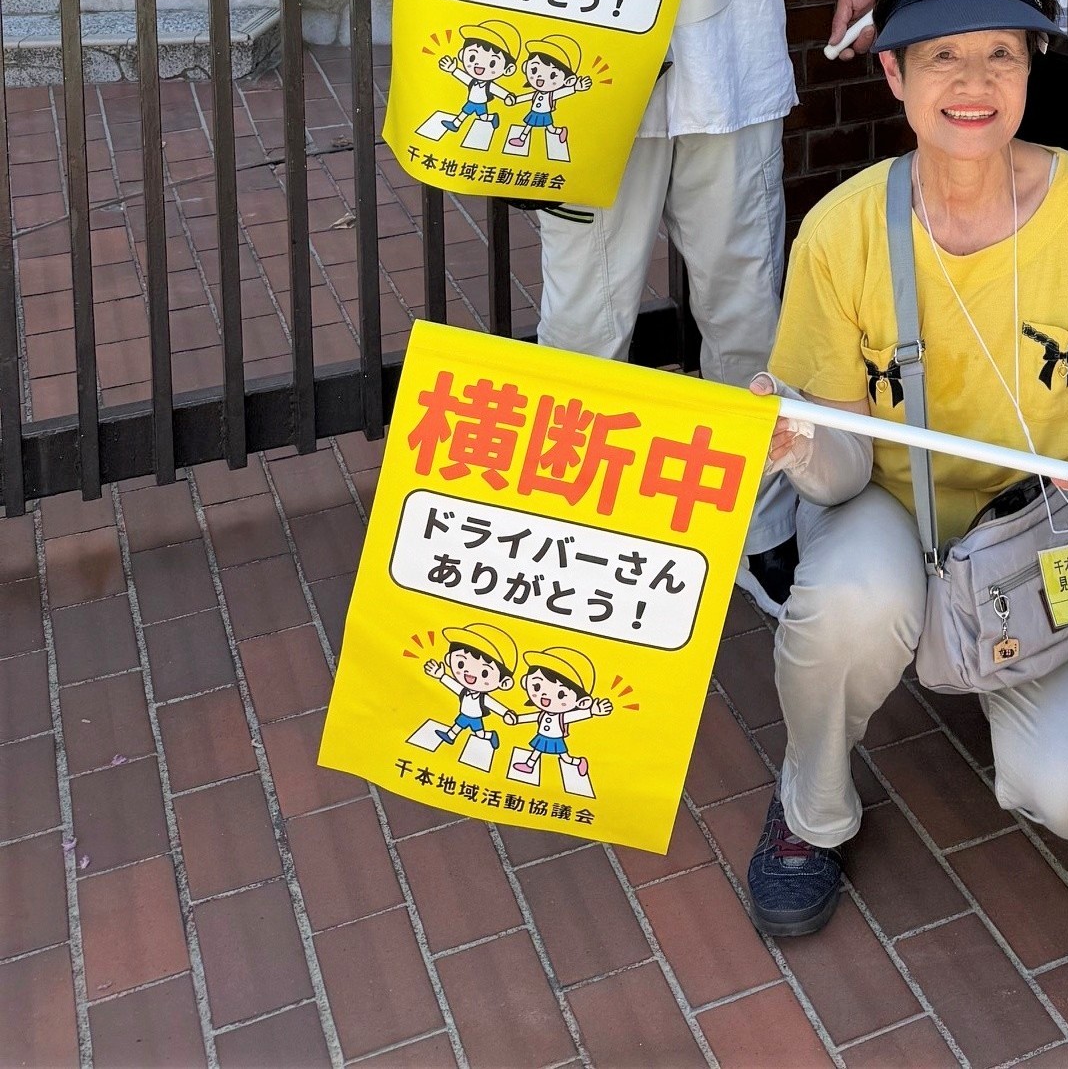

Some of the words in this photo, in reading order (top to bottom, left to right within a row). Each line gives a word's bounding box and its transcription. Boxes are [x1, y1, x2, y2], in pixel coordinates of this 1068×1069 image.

[406, 145, 567, 191] 千本地域活動協議会
[408, 369, 747, 532] 横断中
[423, 507, 687, 595] ドライバーさん
[427, 553, 647, 630] ありがとう！
[394, 757, 596, 826] 千本地域活動協議会
